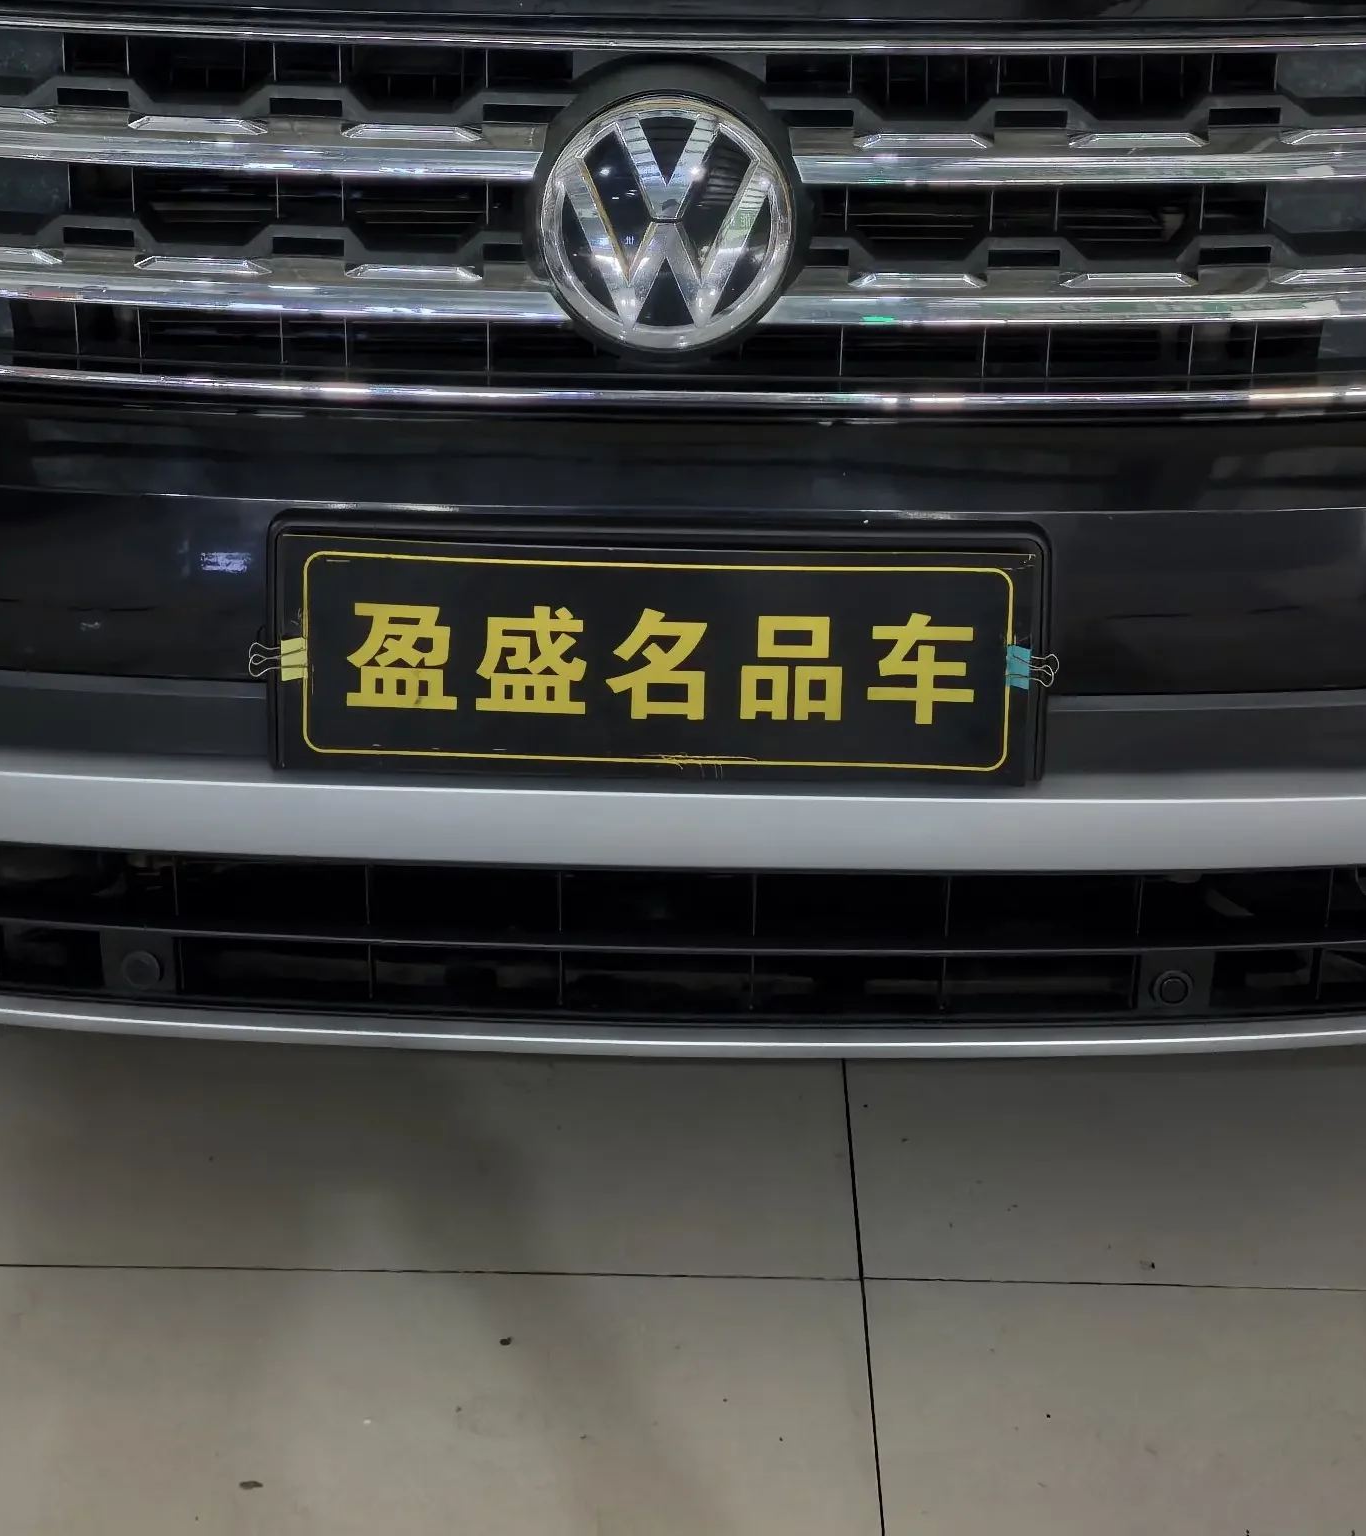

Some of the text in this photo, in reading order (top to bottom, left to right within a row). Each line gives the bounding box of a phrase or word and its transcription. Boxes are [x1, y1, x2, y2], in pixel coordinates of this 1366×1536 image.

[346, 602, 975, 725] 盈盛名品车
